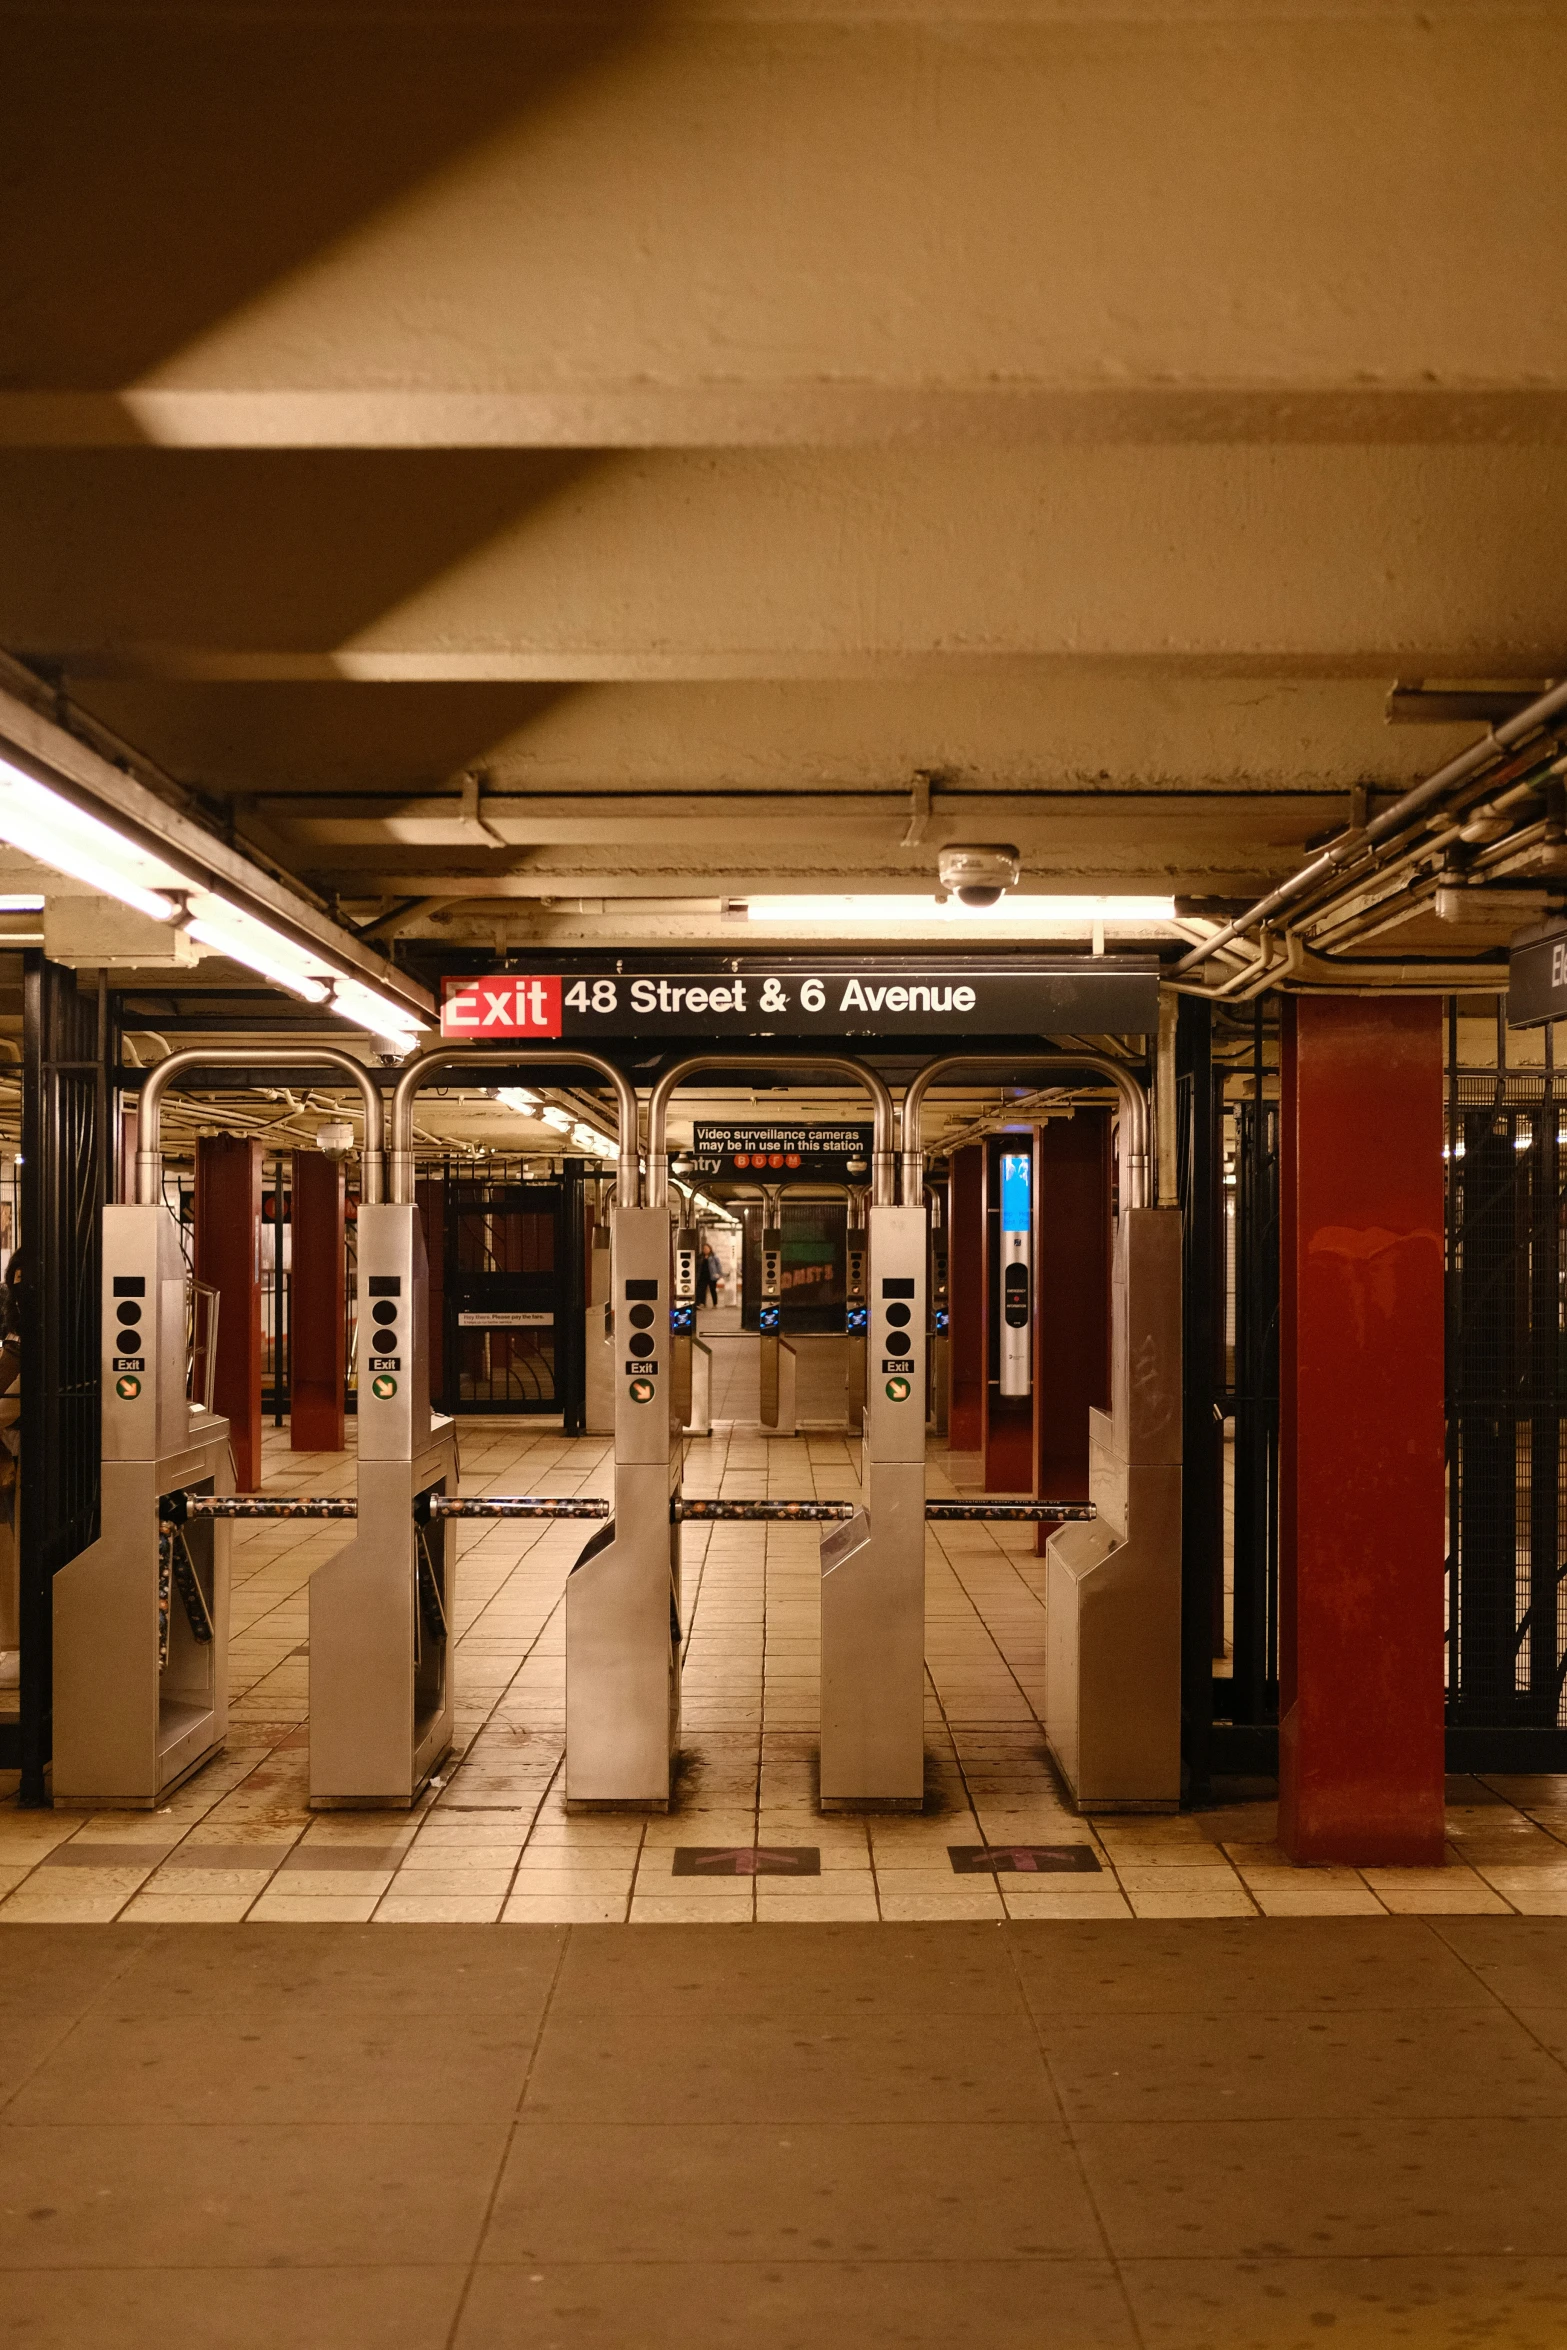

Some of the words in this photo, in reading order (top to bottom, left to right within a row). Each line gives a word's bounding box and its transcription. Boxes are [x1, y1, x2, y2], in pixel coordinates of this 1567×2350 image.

[446, 981, 548, 1026] Exit
[564, 980, 618, 1013] 48
[630, 979, 747, 1013] Street
[759, 978, 788, 1013] &
[800, 979, 826, 1012] 6
[839, 979, 976, 1012] Avenue
[697, 1128, 731, 1140] Video
[733, 1128, 806, 1140] surveillance
[808, 1130, 859, 1140] cameras
[699, 1141, 725, 1153] may
[727, 1140, 742, 1151] be
[744, 1140, 756, 1151] in
[759, 1142, 781, 1151] use
[783, 1140, 795, 1151] in
[797, 1140, 820, 1151] this
[822, 1140, 864, 1151] station
[690, 1156, 722, 1174] ntry
[737, 1156, 746, 1166] B
[755, 1156, 765, 1166] D
[118, 1360, 140, 1370] Exit
[374, 1360, 396, 1370] Exit
[631, 1363, 653, 1373] Exit
[887, 1361, 909, 1371] Exit
